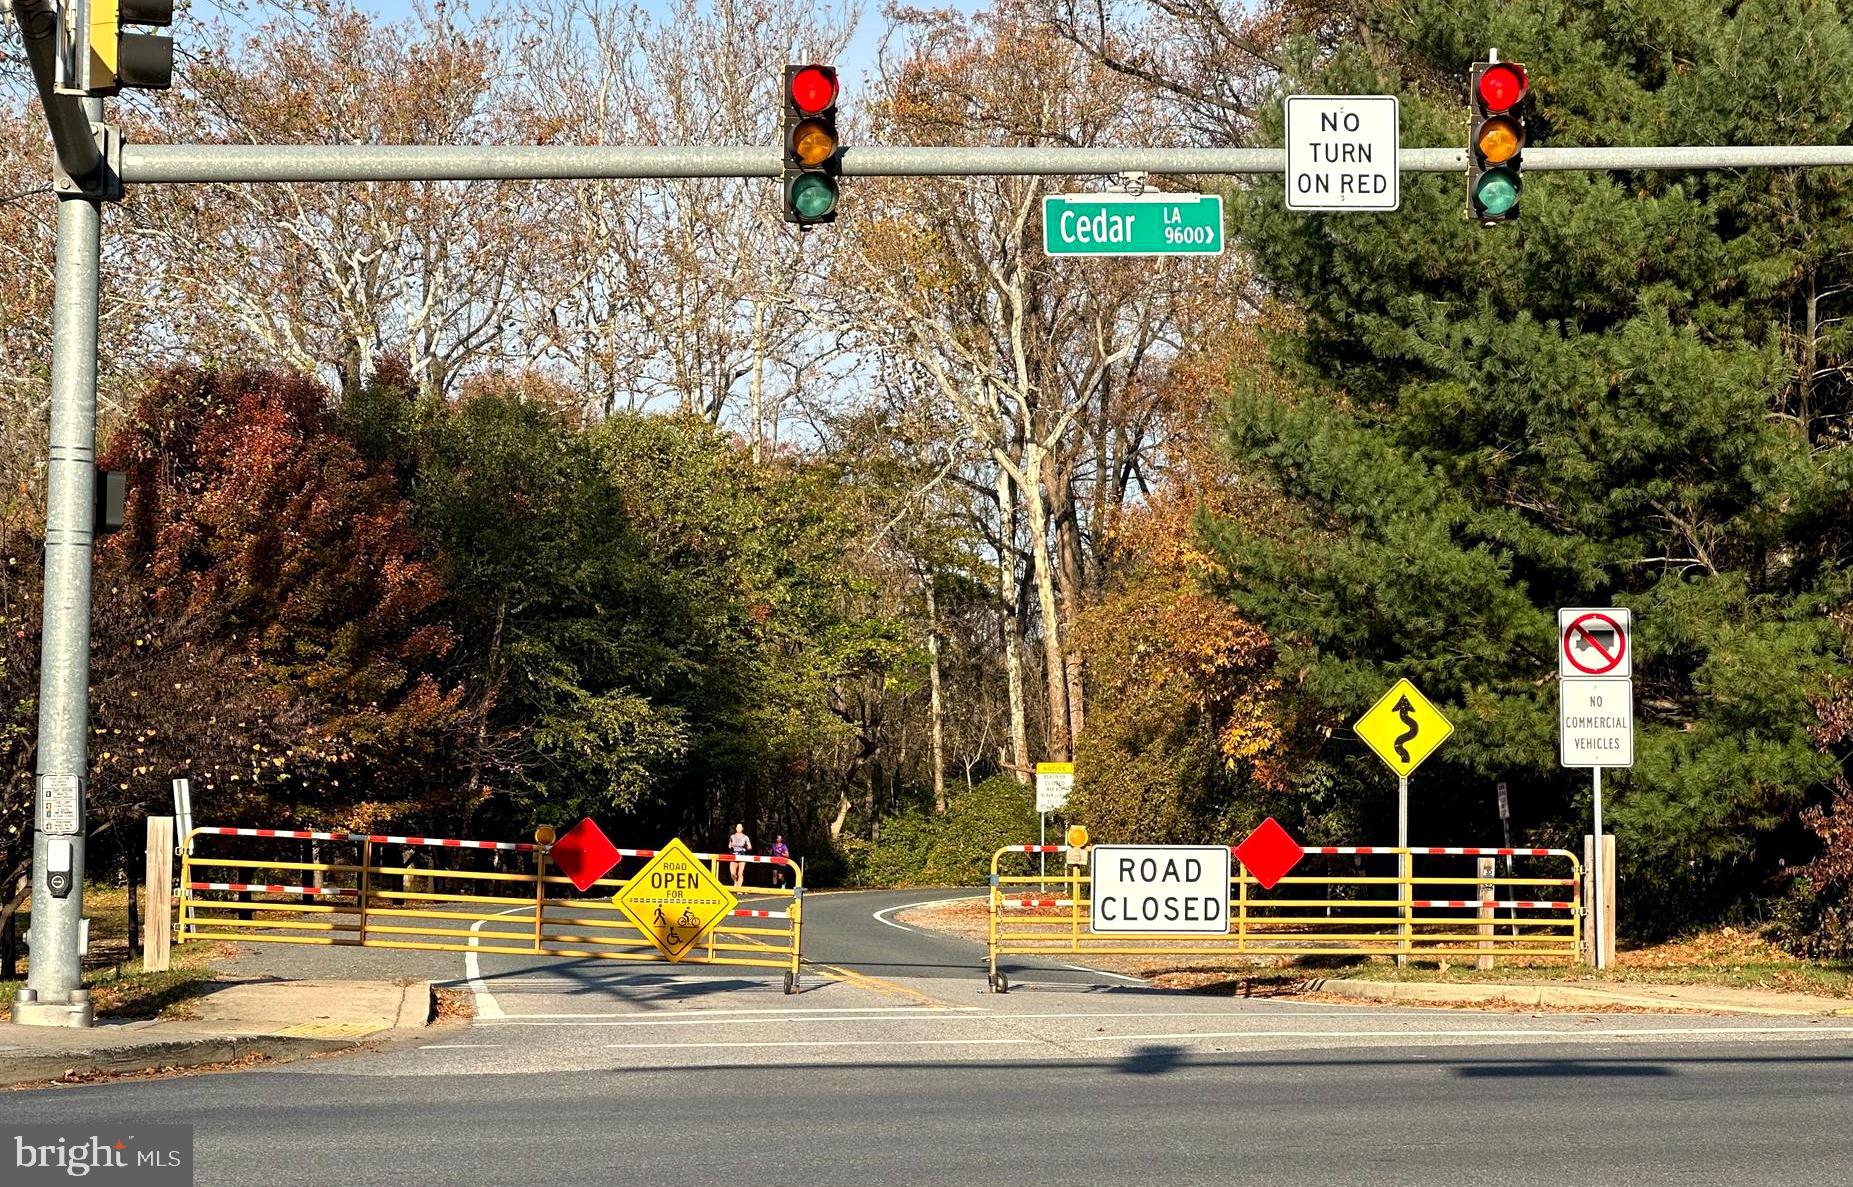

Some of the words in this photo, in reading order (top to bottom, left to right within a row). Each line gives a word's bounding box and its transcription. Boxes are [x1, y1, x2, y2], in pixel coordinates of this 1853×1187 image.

[1321, 112, 1360, 132] NO
[1309, 143, 1372, 163] TURN
[1297, 173, 1330, 193] ON
[1341, 174, 1387, 194] RED
[1163, 207, 1182, 224] LA
[1060, 210, 1136, 243] Cedar
[1164, 226, 1204, 244] 9600
[1589, 696, 1603, 708] NO
[1565, 716, 1628, 729] COMMERCIAL
[1574, 737, 1620, 750] VEHICLES
[663, 862, 687, 871] ROAD
[1119, 858, 1202, 883] ROAD
[651, 872, 699, 889] OPEN
[666, 890, 684, 898] FOR
[1100, 896, 1220, 921] CLOSED
